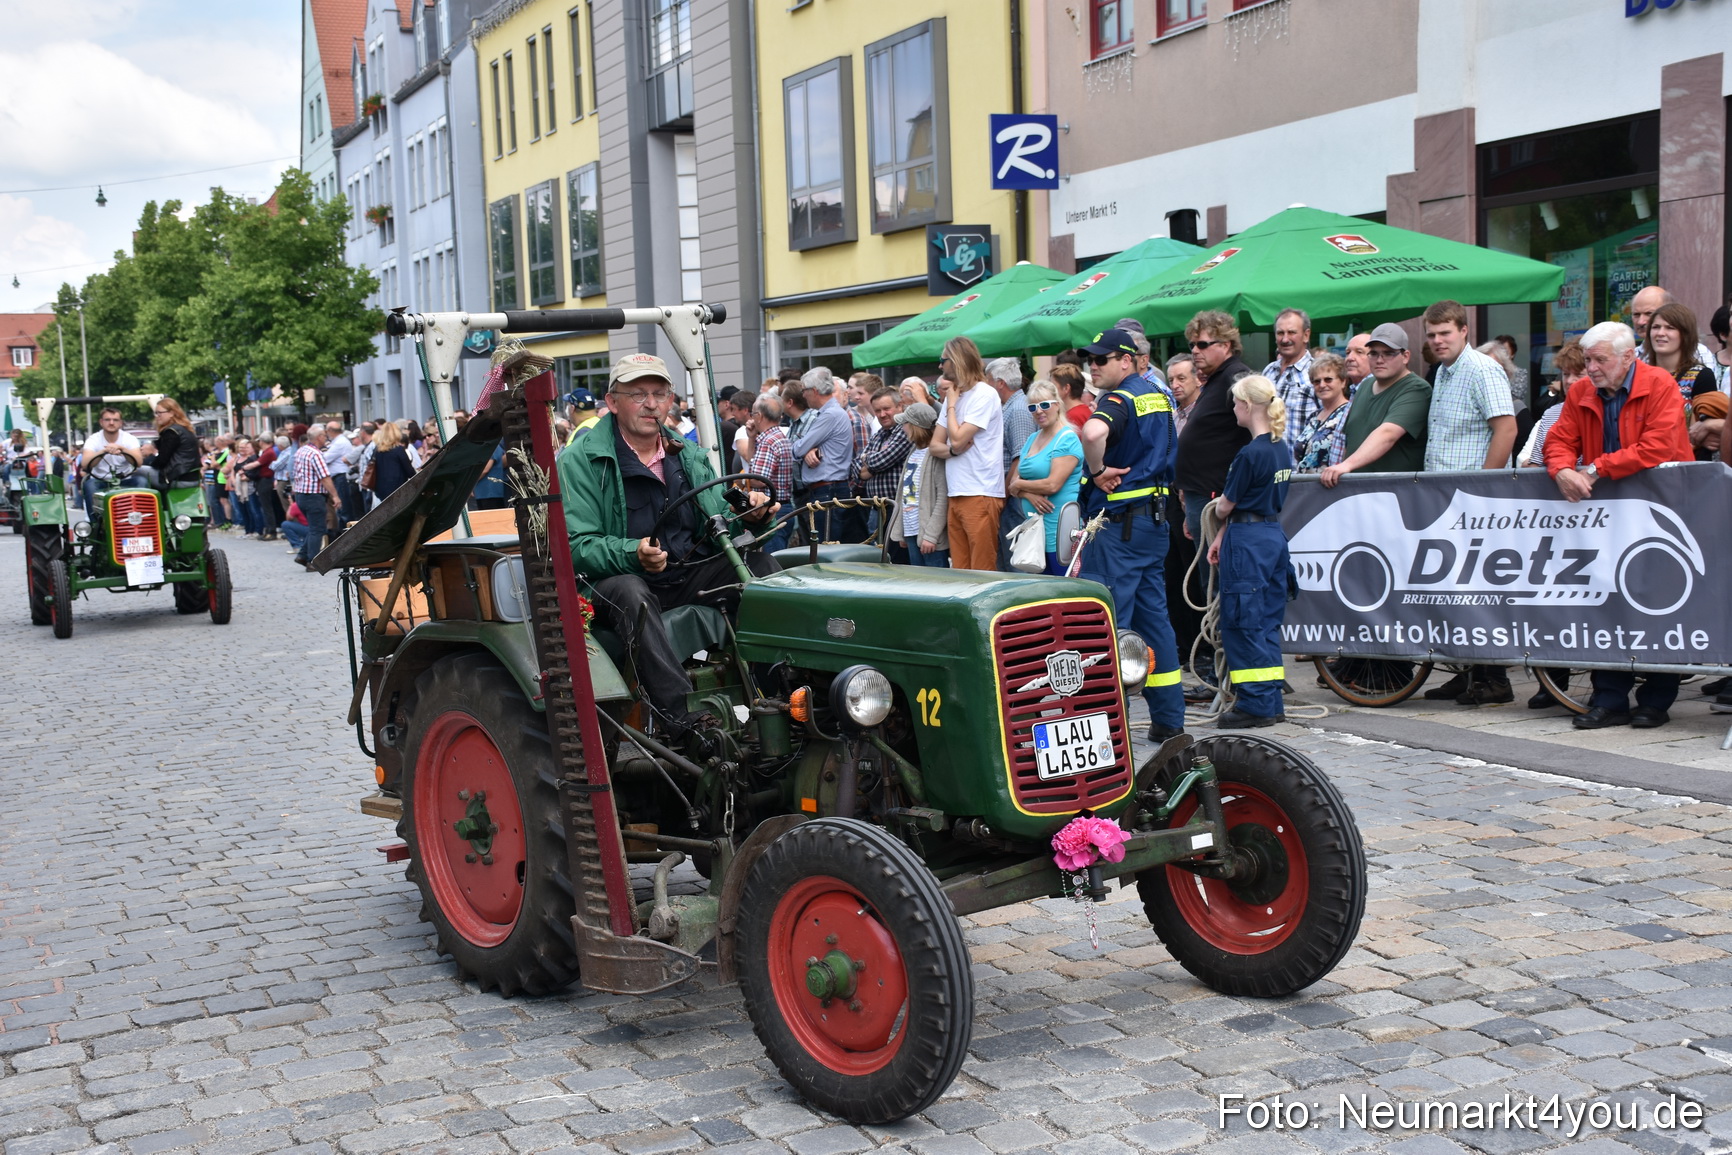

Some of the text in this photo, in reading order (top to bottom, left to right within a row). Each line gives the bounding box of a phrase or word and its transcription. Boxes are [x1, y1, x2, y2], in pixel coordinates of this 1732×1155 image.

[1065, 201, 1118, 224] Unterer Markt 15
[954, 243, 976, 272] G2
[1329, 255, 1427, 270] Neumarkter
[1320, 262, 1461, 281] Lammsbräu
[1613, 269, 1649, 282] GARTEN
[1618, 281, 1645, 292] BUCH
[1449, 507, 1610, 531] Autoklassik
[1407, 535, 1600, 586] Dietz
[1401, 593, 1503, 606] BREITENBRUNN
[1280, 619, 1709, 651] www.autoklassik-dietz.de
[1052, 659, 1078, 678] HELA
[1055, 677, 1080, 688] DIESEL
[916, 687, 941, 727] 12
[1054, 719, 1093, 747] LAU
[1039, 740, 1046, 748] D
